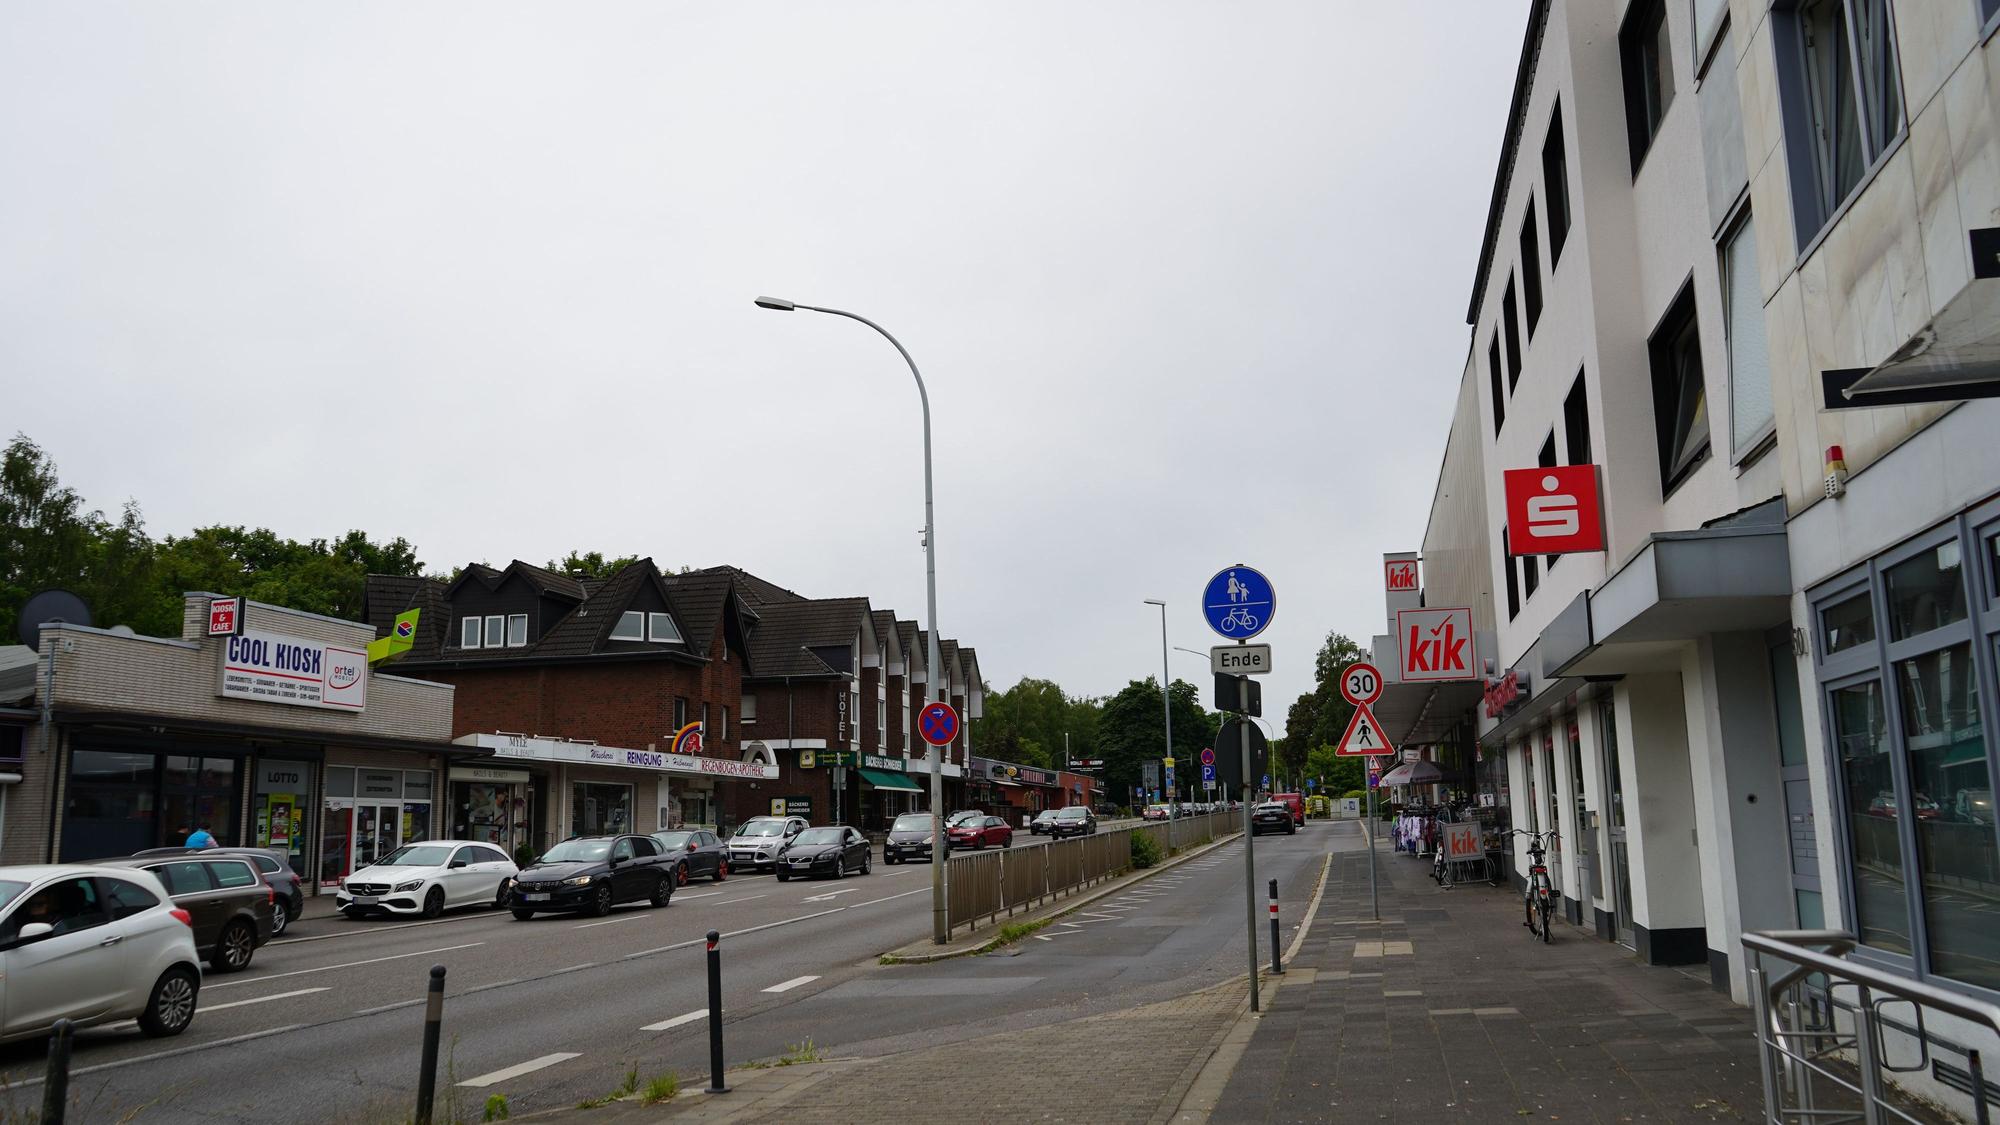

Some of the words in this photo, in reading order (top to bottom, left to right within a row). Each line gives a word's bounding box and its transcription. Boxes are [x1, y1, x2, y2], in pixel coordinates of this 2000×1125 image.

[1389, 564, 1415, 588] kik
[212, 603, 234, 613] KIOSK
[219, 614, 226, 622] &
[1407, 614, 1467, 672] kik
[229, 635, 270, 667] COOL
[275, 643, 322, 675] KIOSK
[1221, 652, 1261, 668] Ende
[334, 666, 354, 676] ortel
[1350, 674, 1374, 695] 30
[838, 691, 847, 742] HOTEL
[627, 751, 662, 767] REINIGUNG
[701, 758, 764, 778] REGENBOGEN-APOTHEKE
[268, 772, 299, 784] LOTTO
[1204, 767, 1213, 779] P
[1451, 826, 1478, 855] kik
